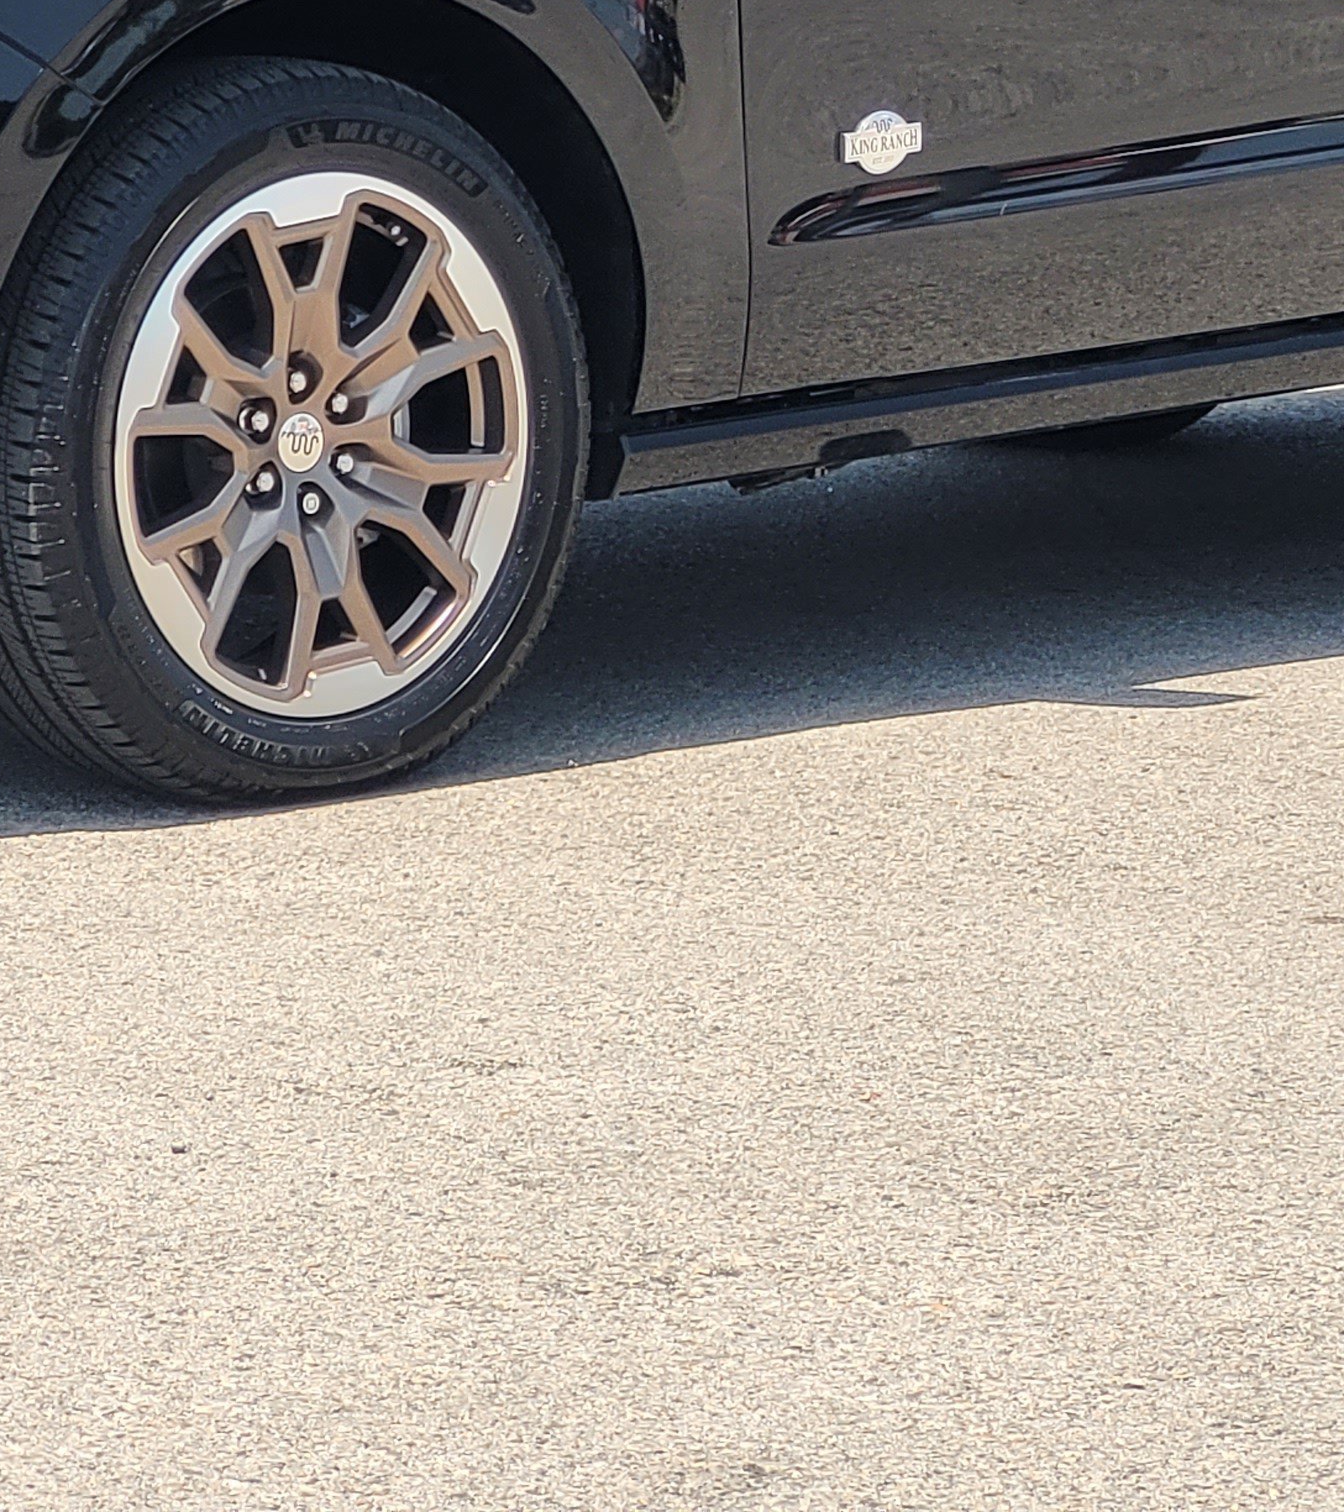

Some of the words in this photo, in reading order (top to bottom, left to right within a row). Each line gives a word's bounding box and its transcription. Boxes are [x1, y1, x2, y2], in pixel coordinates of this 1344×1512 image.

[335, 120, 482, 192] MICHELIN
[850, 137, 877, 156] KING
[881, 128, 918, 151] RANCH
